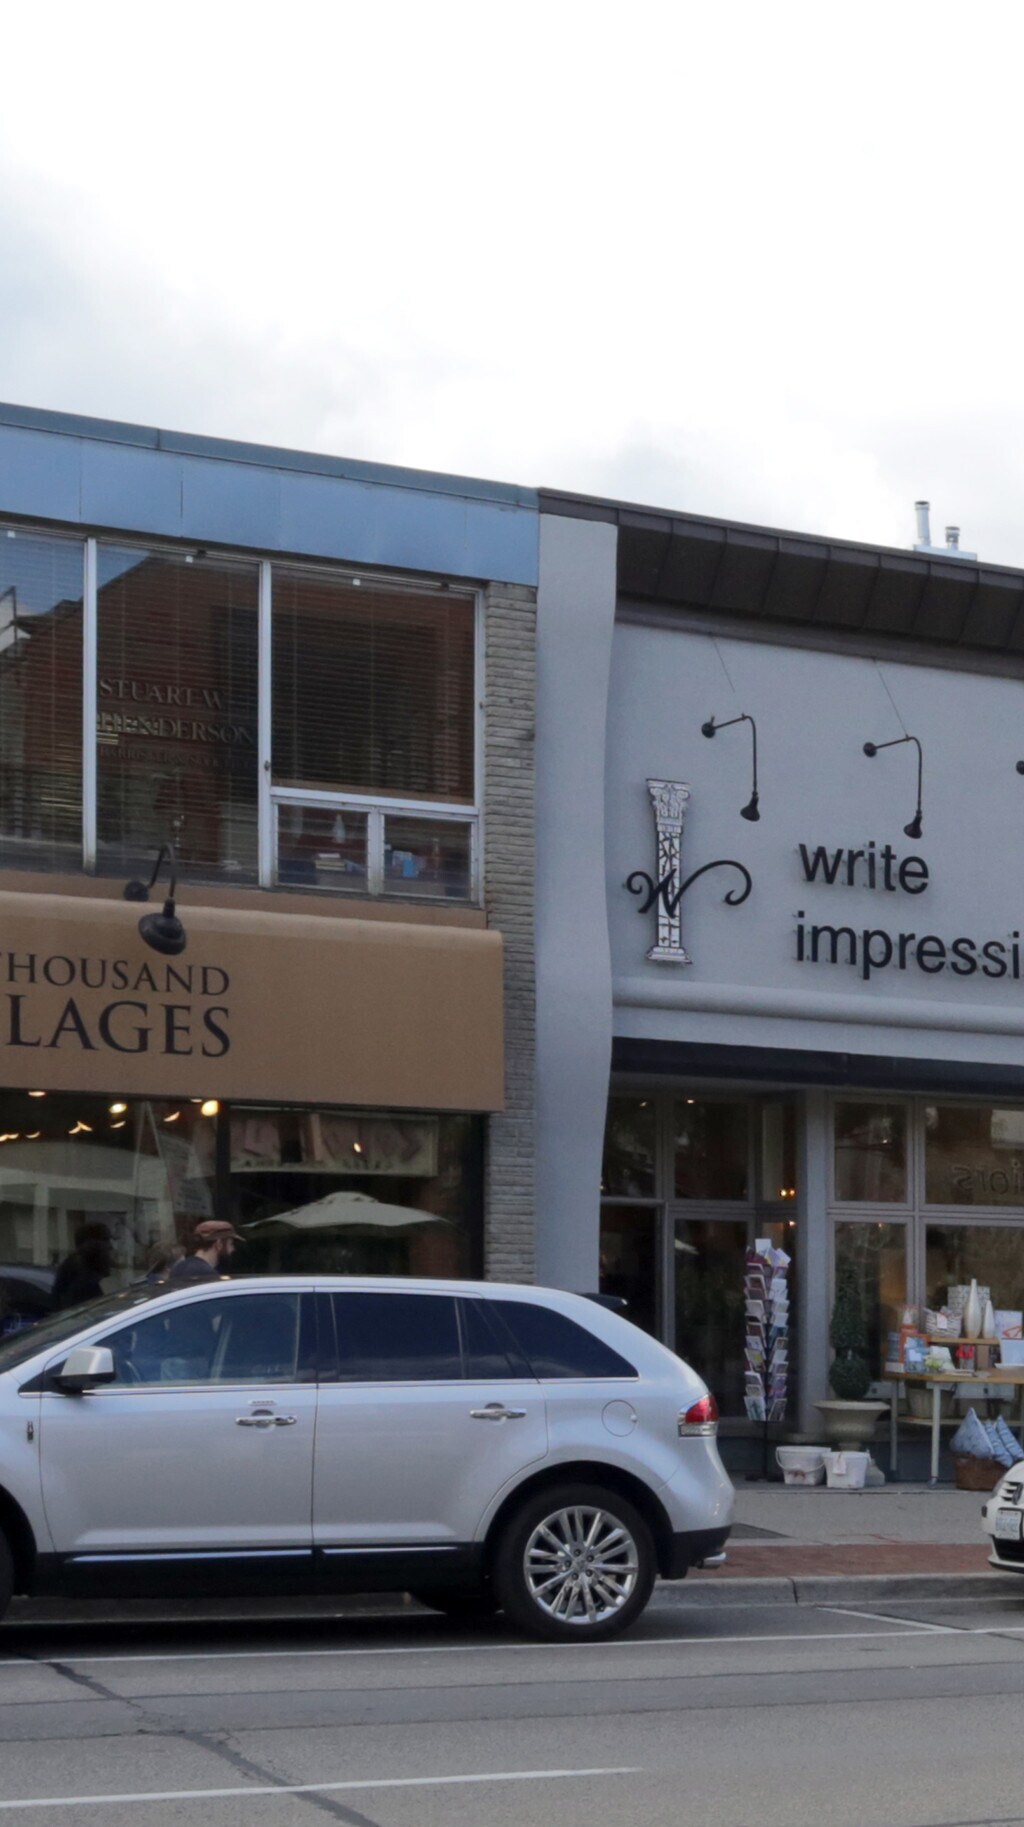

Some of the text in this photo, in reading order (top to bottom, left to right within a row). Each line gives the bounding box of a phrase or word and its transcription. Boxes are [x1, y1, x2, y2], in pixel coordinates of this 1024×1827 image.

[100, 679, 194, 706] STUART
[100, 711, 255, 745] HENDERSON
[798, 841, 929, 894] write
[0, 953, 230, 996] HOUSAND
[5, 993, 231, 1058] LAGES
